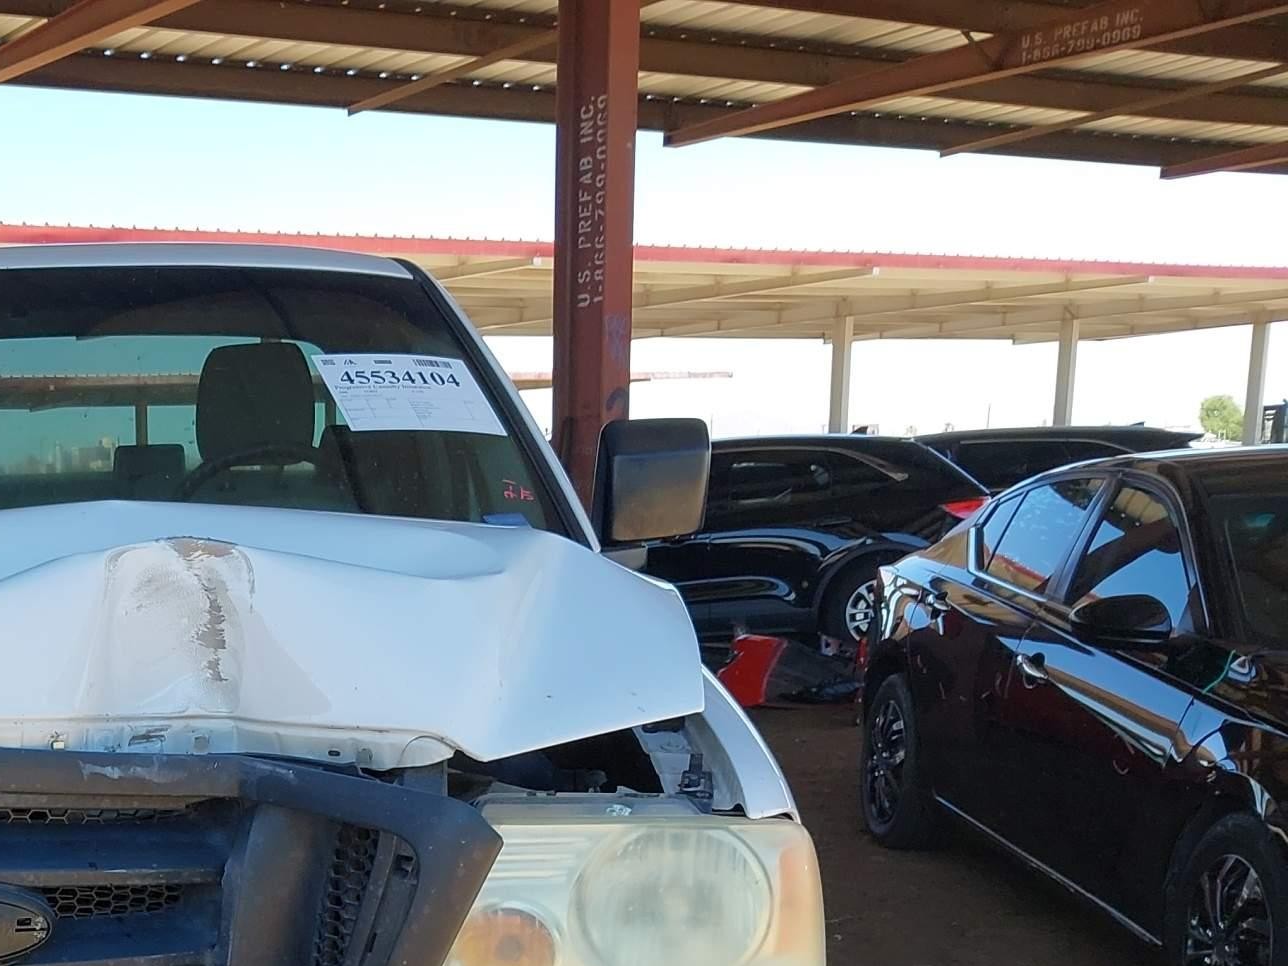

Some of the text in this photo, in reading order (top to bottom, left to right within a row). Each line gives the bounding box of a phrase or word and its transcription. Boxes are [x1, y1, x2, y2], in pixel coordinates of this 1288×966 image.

[1021, 8, 1144, 49] U.S. PREFAB INC.
[577, 95, 595, 308] U.S. PREFAB INC.
[340, 370, 461, 387] 45534104
